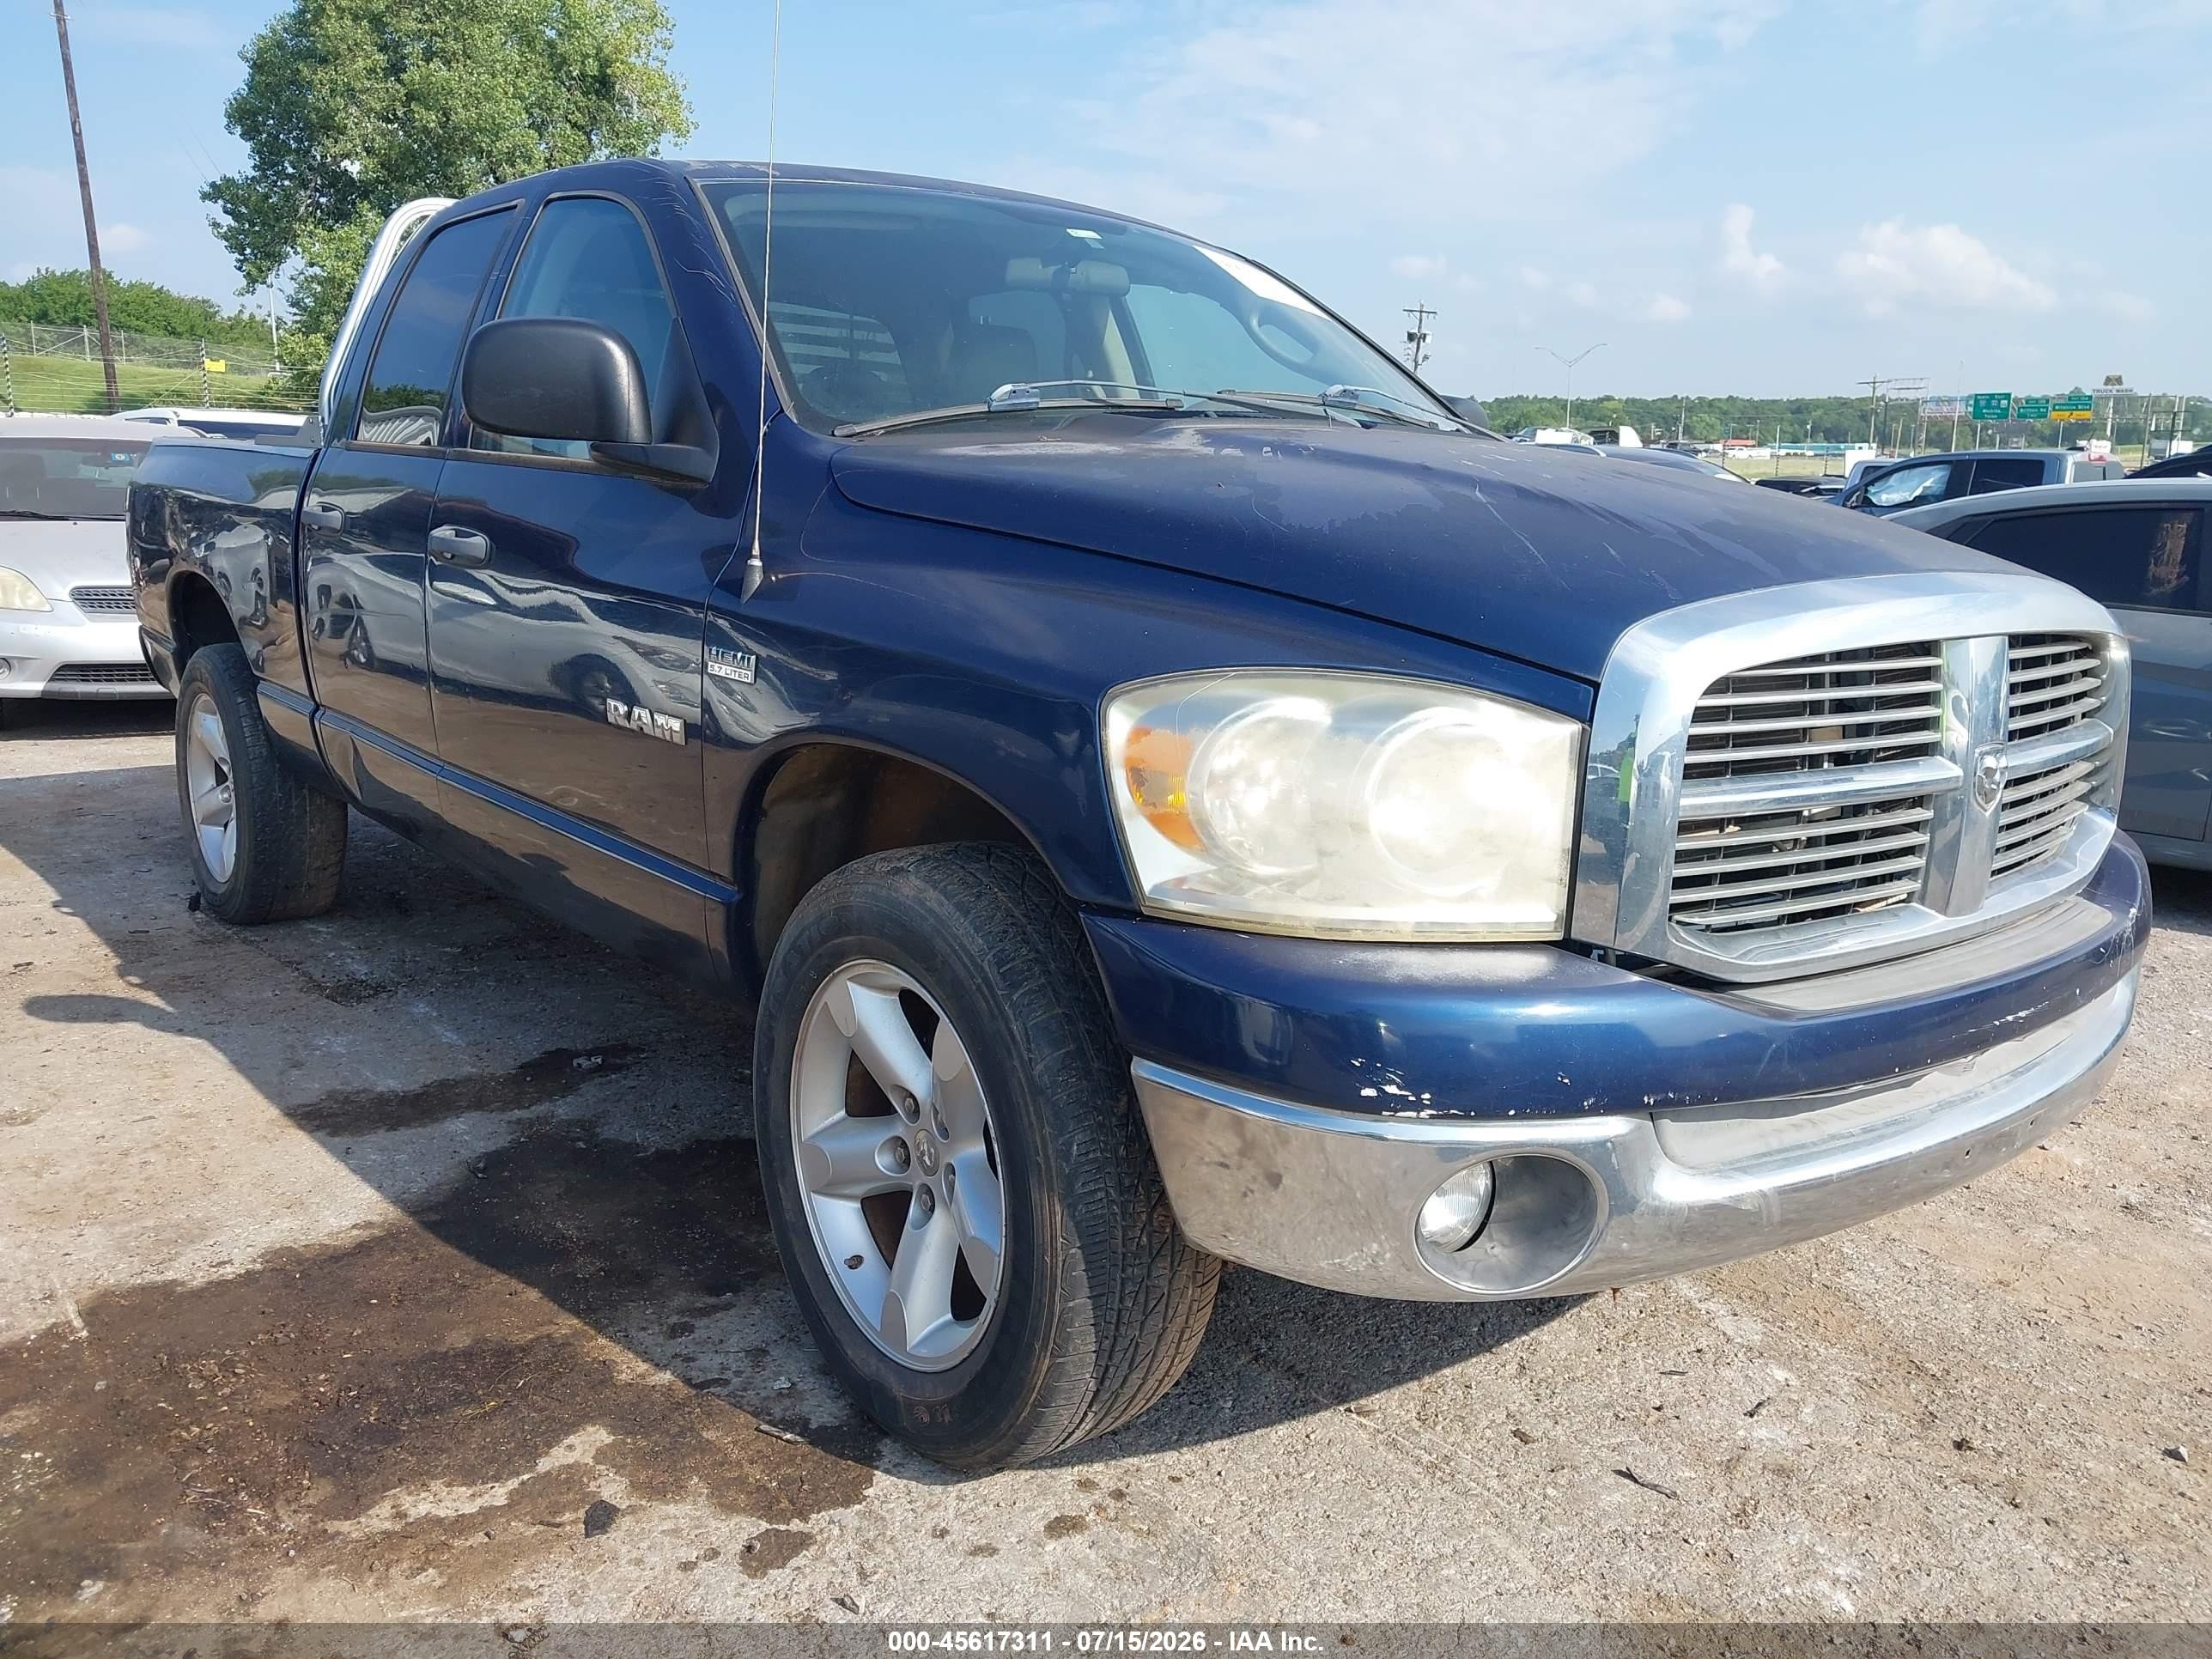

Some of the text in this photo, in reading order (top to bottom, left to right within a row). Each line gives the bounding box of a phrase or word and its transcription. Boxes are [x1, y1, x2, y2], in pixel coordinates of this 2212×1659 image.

[708, 647, 756, 668] HEMI
[709, 664, 750, 681] 5.7 LITER
[606, 698, 686, 745] RAM
